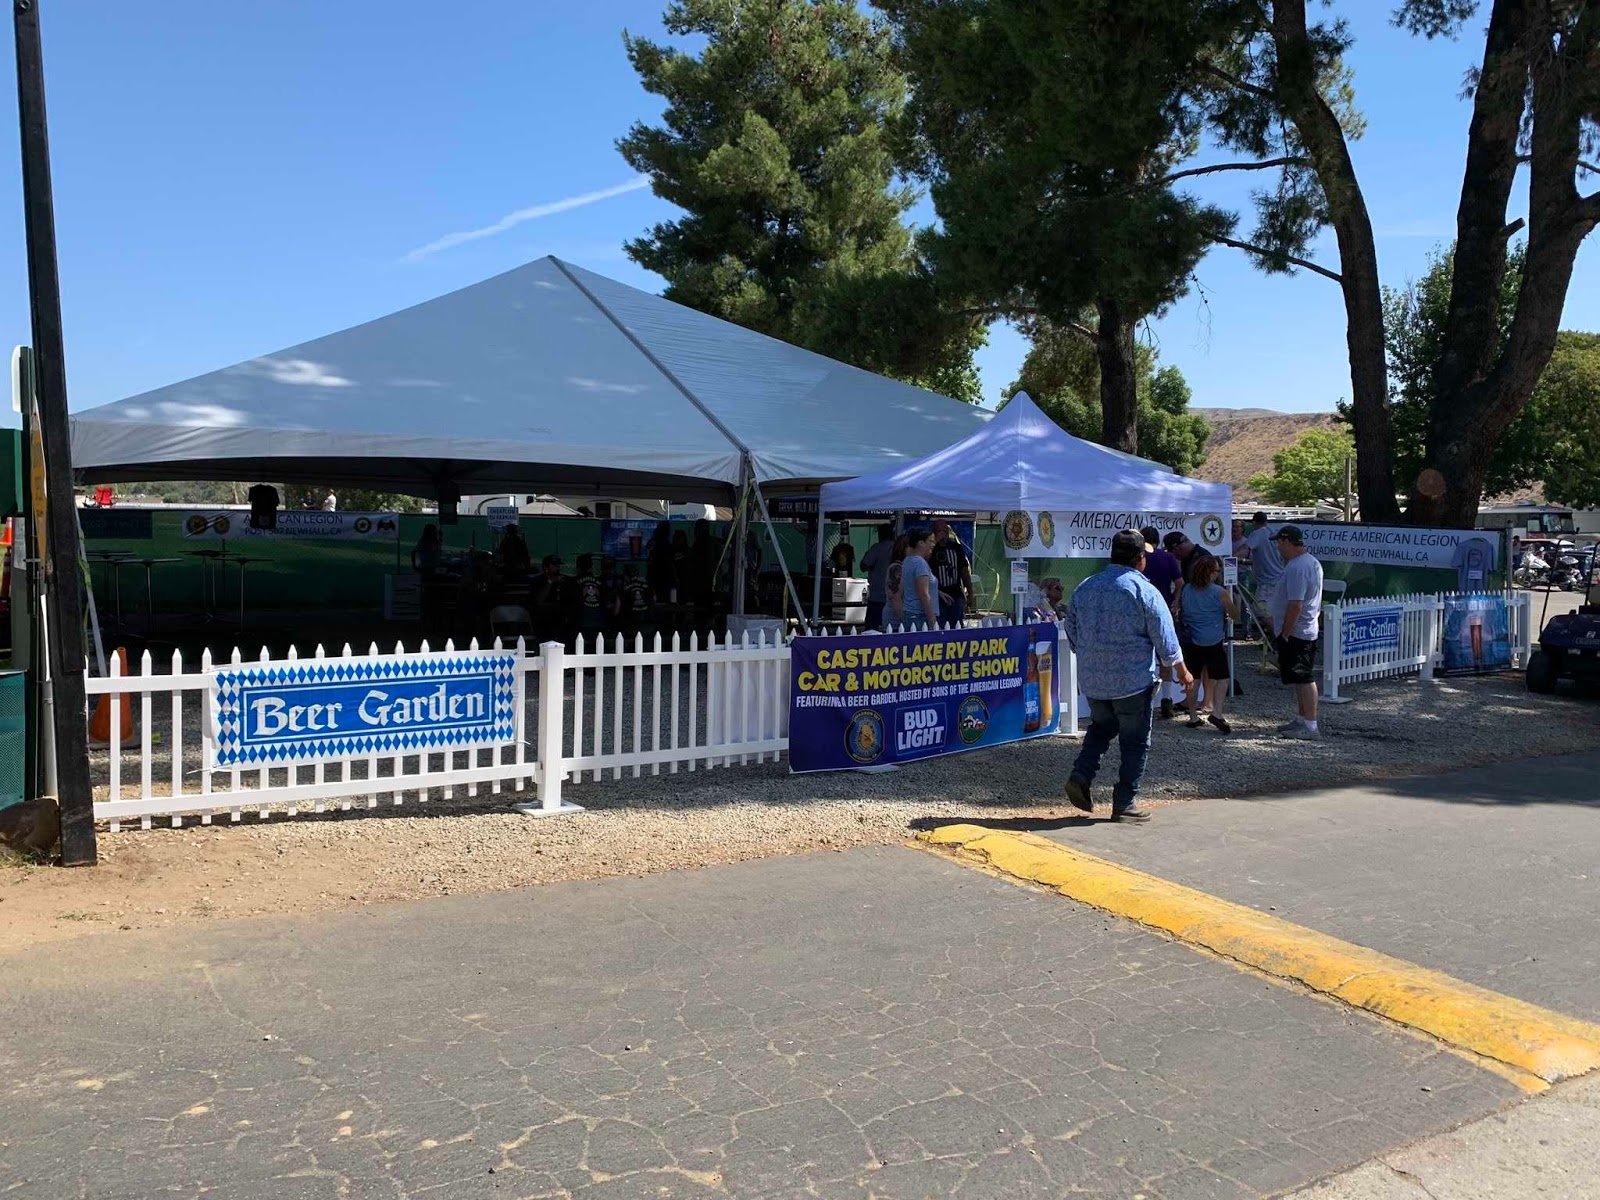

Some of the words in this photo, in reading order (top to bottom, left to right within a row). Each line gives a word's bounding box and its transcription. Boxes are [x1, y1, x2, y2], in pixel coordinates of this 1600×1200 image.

[303, 515, 344, 524] LEGION
[1070, 512, 1144, 530] AMERICAN
[1071, 537, 1097, 550] POST
[1100, 537, 1113, 550] 50
[1311, 530, 1325, 540] OF
[1327, 531, 1348, 541] THE
[1350, 532, 1410, 546] AMERICAN
[1412, 535, 1459, 547] LEGION
[1350, 548, 1366, 557] 507
[1367, 549, 1413, 562] NEWHALL,
[1414, 551, 1429, 561] CA
[1348, 621, 1367, 643] Beer
[1369, 616, 1398, 639] Garden
[817, 647, 900, 670] CASTAIC
[902, 643, 943, 664] LAKE
[945, 640, 968, 660] RV
[968, 637, 1009, 657] PARK
[797, 671, 842, 692] CAR
[844, 672, 859, 692] &
[863, 660, 970, 690] MOTORCYCLE
[971, 656, 1020, 678] SHOW!
[847, 695, 869, 706] BEER
[870, 692, 898, 706] GARDEN,
[899, 689, 922, 702] HOSTED
[923, 687, 932, 699] BY
[932, 686, 948, 698] SONS
[949, 684, 958, 696] OF
[958, 683, 969, 695] THE
[969, 680, 999, 693] AMERICAN
[249, 696, 343, 736] Beer
[358, 684, 486, 727] Garden
[904, 709, 938, 730] BUD
[897, 726, 945, 751] LIGHT
